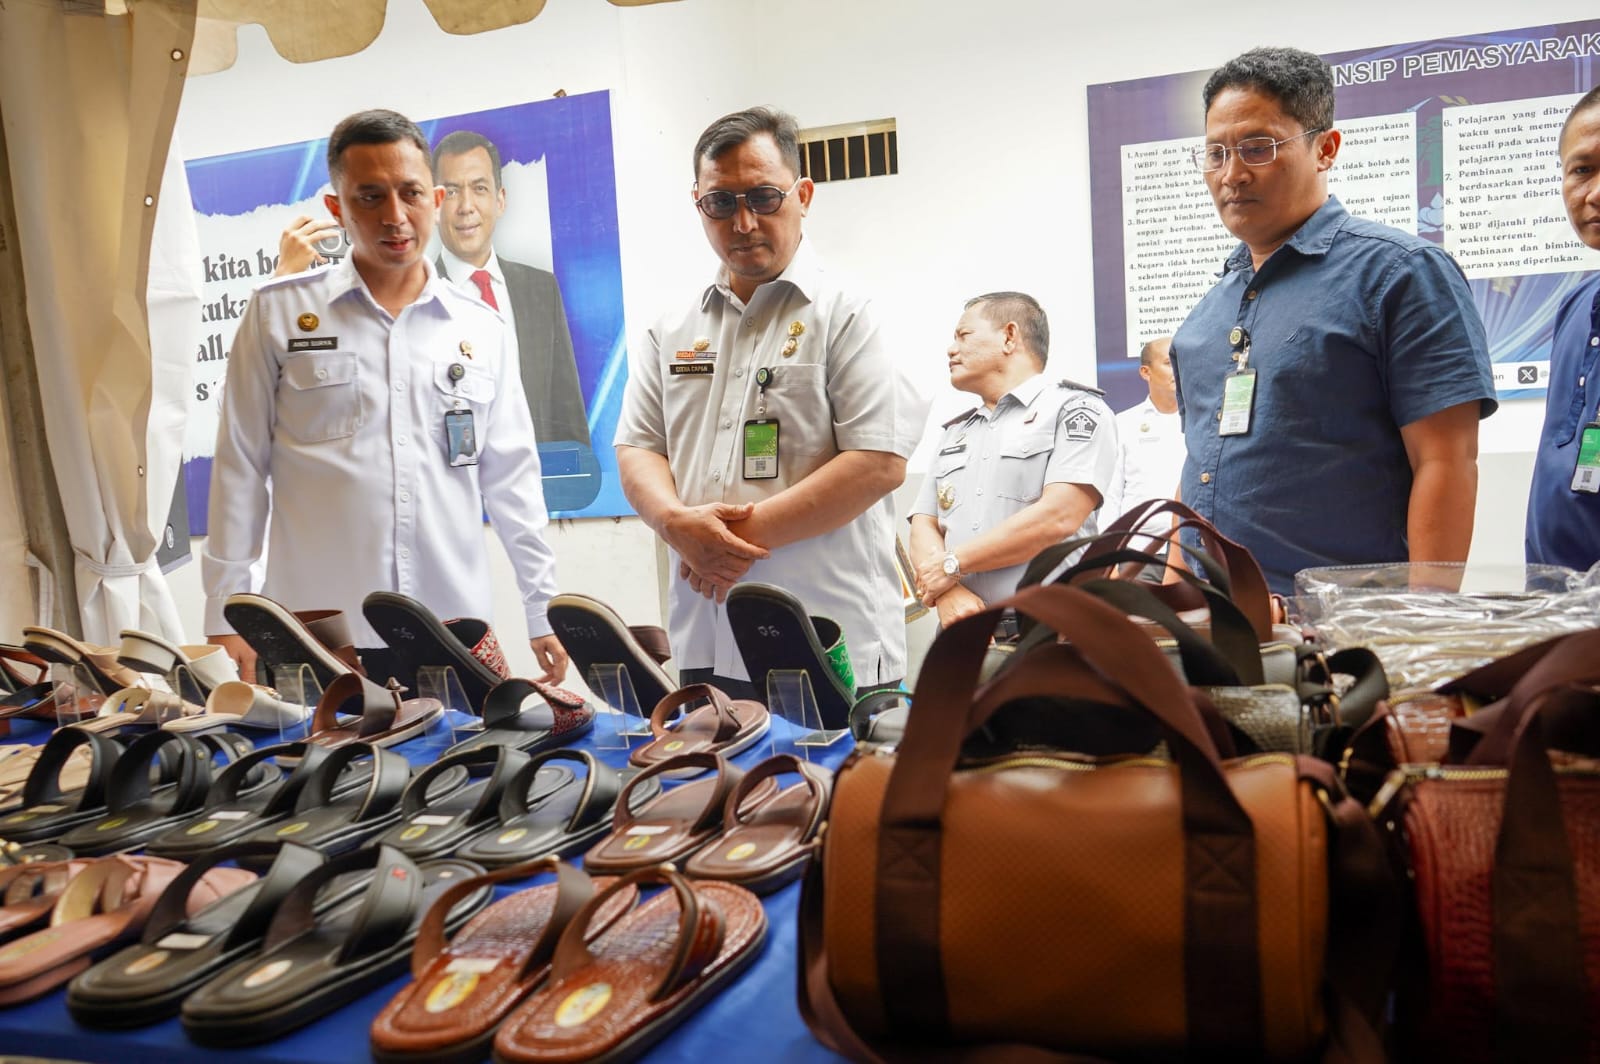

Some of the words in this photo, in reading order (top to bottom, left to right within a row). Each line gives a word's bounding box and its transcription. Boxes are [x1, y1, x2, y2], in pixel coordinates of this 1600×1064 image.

[1333, 57, 1397, 87] NSIP
[1402, 32, 1600, 79] PEMASYARAK
[1458, 113, 1506, 125] Pelajaran
[1512, 111, 1536, 120] yang
[1458, 129, 1489, 138] waktu
[1494, 124, 1524, 134] untuk
[1529, 121, 1564, 131] memen
[1458, 141, 1495, 151] kecuali
[1498, 137, 1522, 148] pada
[1525, 135, 1557, 144] waktu
[1134, 161, 1158, 169] (WBP)
[1344, 136, 1377, 146] sebagai
[1383, 135, 1410, 143] warga
[1162, 147, 1177, 155] dan
[1342, 162, 1364, 171] tidak
[1368, 159, 1391, 168] boleh
[1394, 156, 1410, 165] ada
[1459, 154, 1506, 166] pelajaran
[1508, 151, 1533, 161] yang
[1459, 167, 1513, 178] Pembinaan
[1523, 163, 1546, 172] atau
[1135, 183, 1162, 192] Pidana
[1165, 181, 1190, 189] bukan
[1185, 190, 1209, 199] kepad
[1347, 172, 1385, 181] tindakan
[1459, 179, 1524, 191] berdasarkan
[1526, 175, 1562, 187] kepada
[1345, 197, 1376, 206] dengan
[1383, 193, 1410, 203] tujuan
[1459, 195, 1482, 205] WBP
[1487, 192, 1517, 202] harus
[1523, 189, 1561, 199] diberik
[1374, 206, 1411, 215] kegiatan
[1459, 209, 1492, 218] benar.
[1391, 217, 1411, 225] yang
[1459, 222, 1482, 231] WBP
[1487, 218, 1526, 229] dijatuhi
[1532, 215, 1567, 226] pidana
[1459, 235, 1490, 244] waktu
[1492, 231, 1537, 241] tertentu.
[1216, 244, 1236, 252] hidu
[1459, 246, 1514, 257] Pembinaan
[1520, 244, 1539, 252] dan
[203, 253, 252, 283] kita
[1137, 261, 1164, 270] Negara
[1167, 258, 1188, 267] tidak
[1497, 260, 1521, 268] yang
[1523, 255, 1583, 266] diperlukan.
